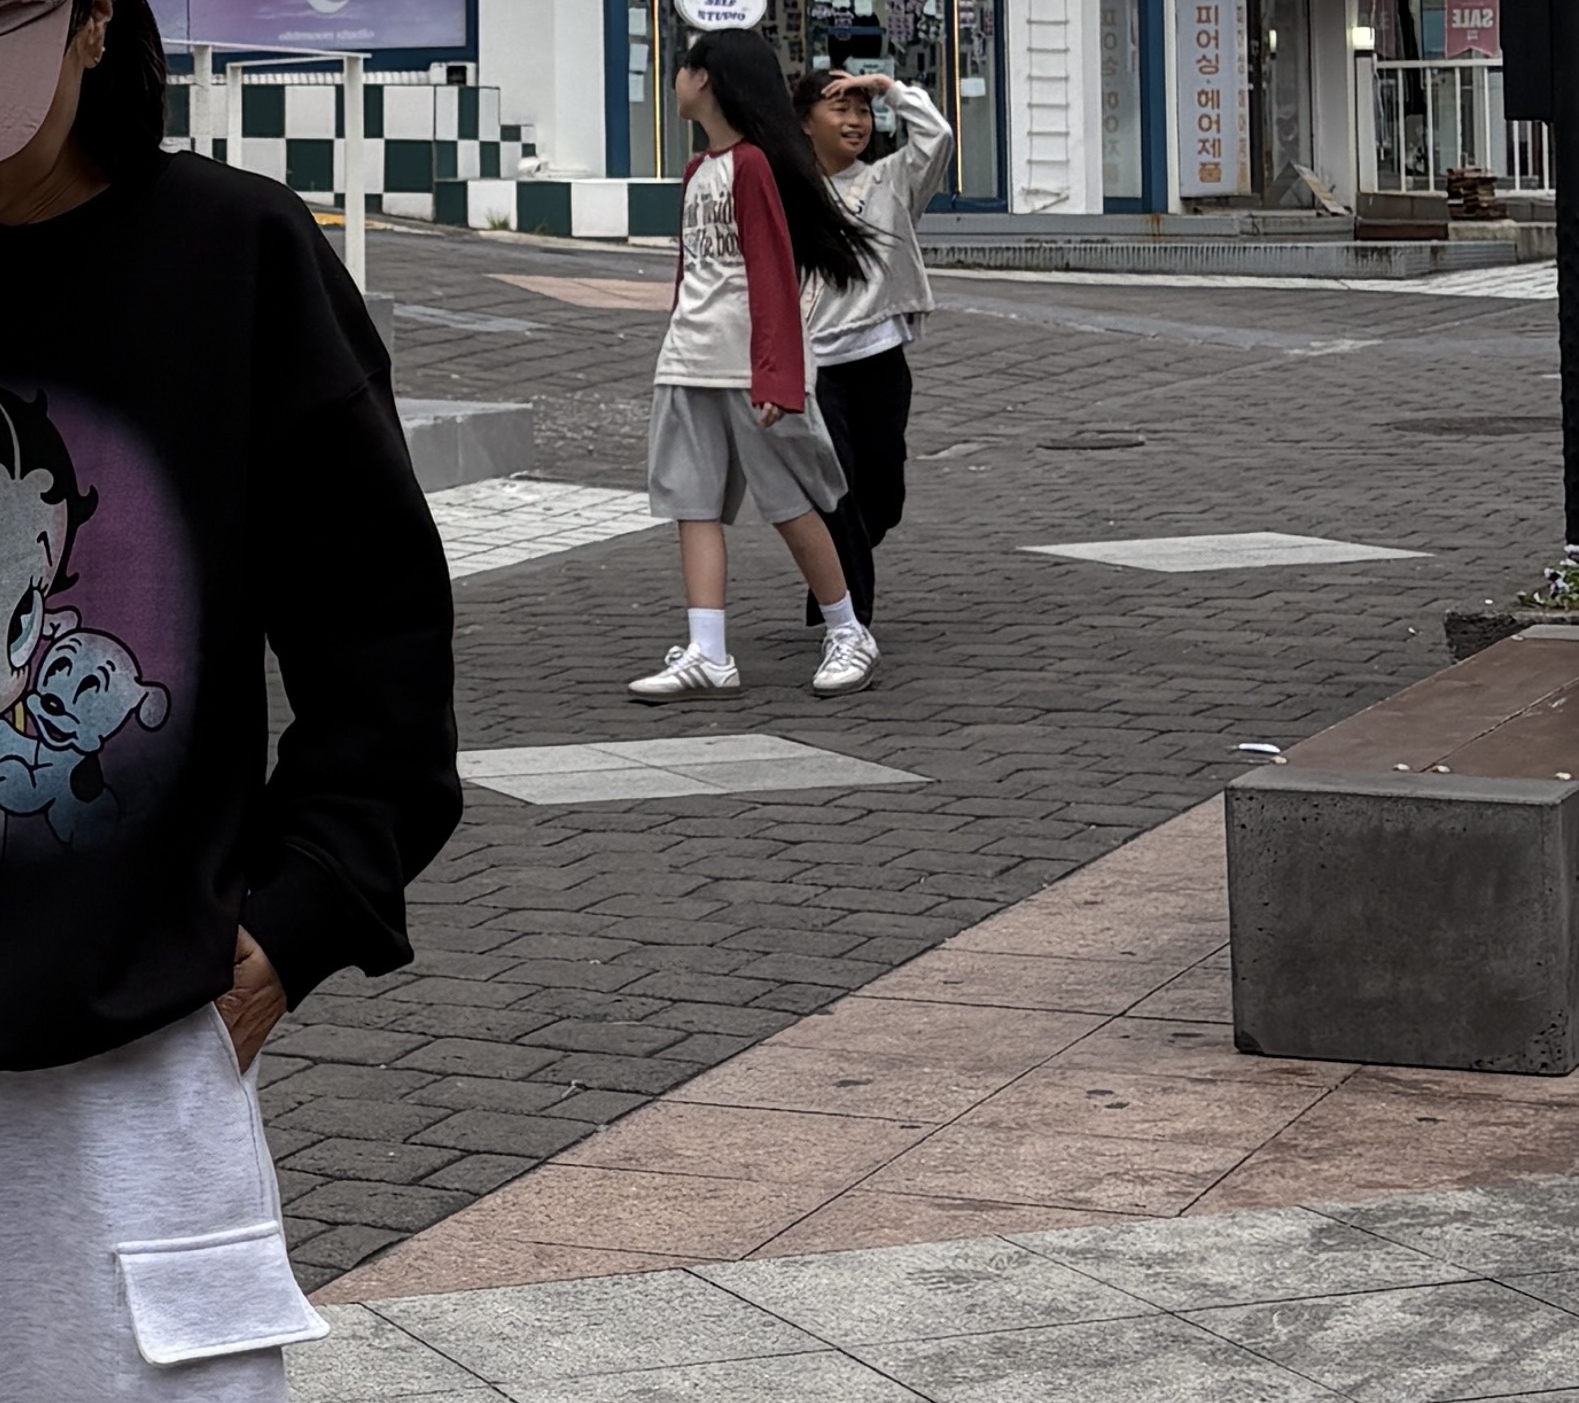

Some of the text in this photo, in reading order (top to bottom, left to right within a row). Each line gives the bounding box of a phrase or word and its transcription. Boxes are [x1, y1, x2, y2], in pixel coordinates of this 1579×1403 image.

[697, 10, 746, 22] STUDIO
[1195, 4, 1220, 76] 피어싱
[1196, 88, 1222, 184] 헤어제품
